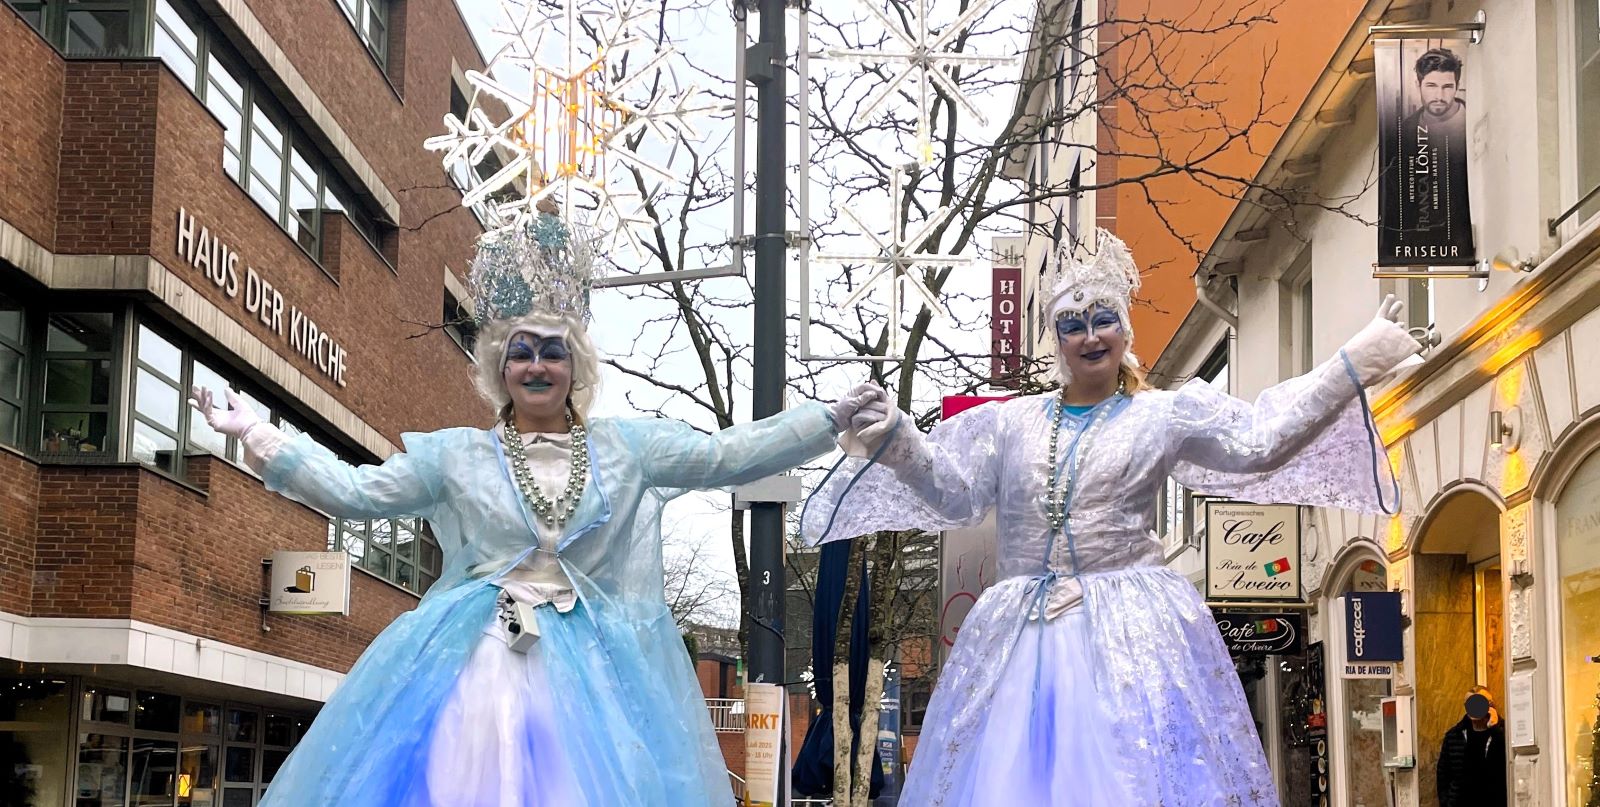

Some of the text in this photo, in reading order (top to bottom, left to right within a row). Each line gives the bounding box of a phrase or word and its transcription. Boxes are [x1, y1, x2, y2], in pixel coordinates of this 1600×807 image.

[1416, 125, 1428, 174] LÖNTZ
[1395, 245, 1459, 257] FRISEUR
[177, 206, 347, 388] HAUS DER KIRCHE
[1222, 520, 1285, 552] Cafe
[1216, 559, 1257, 570] Ria de
[762, 571, 770, 585] 3
[1214, 571, 1291, 590] Aveiro
[1216, 620, 1254, 642] Café
[1352, 597, 1366, 657] caffecel
[1346, 666, 1391, 675] RIA DE AVEIRO
